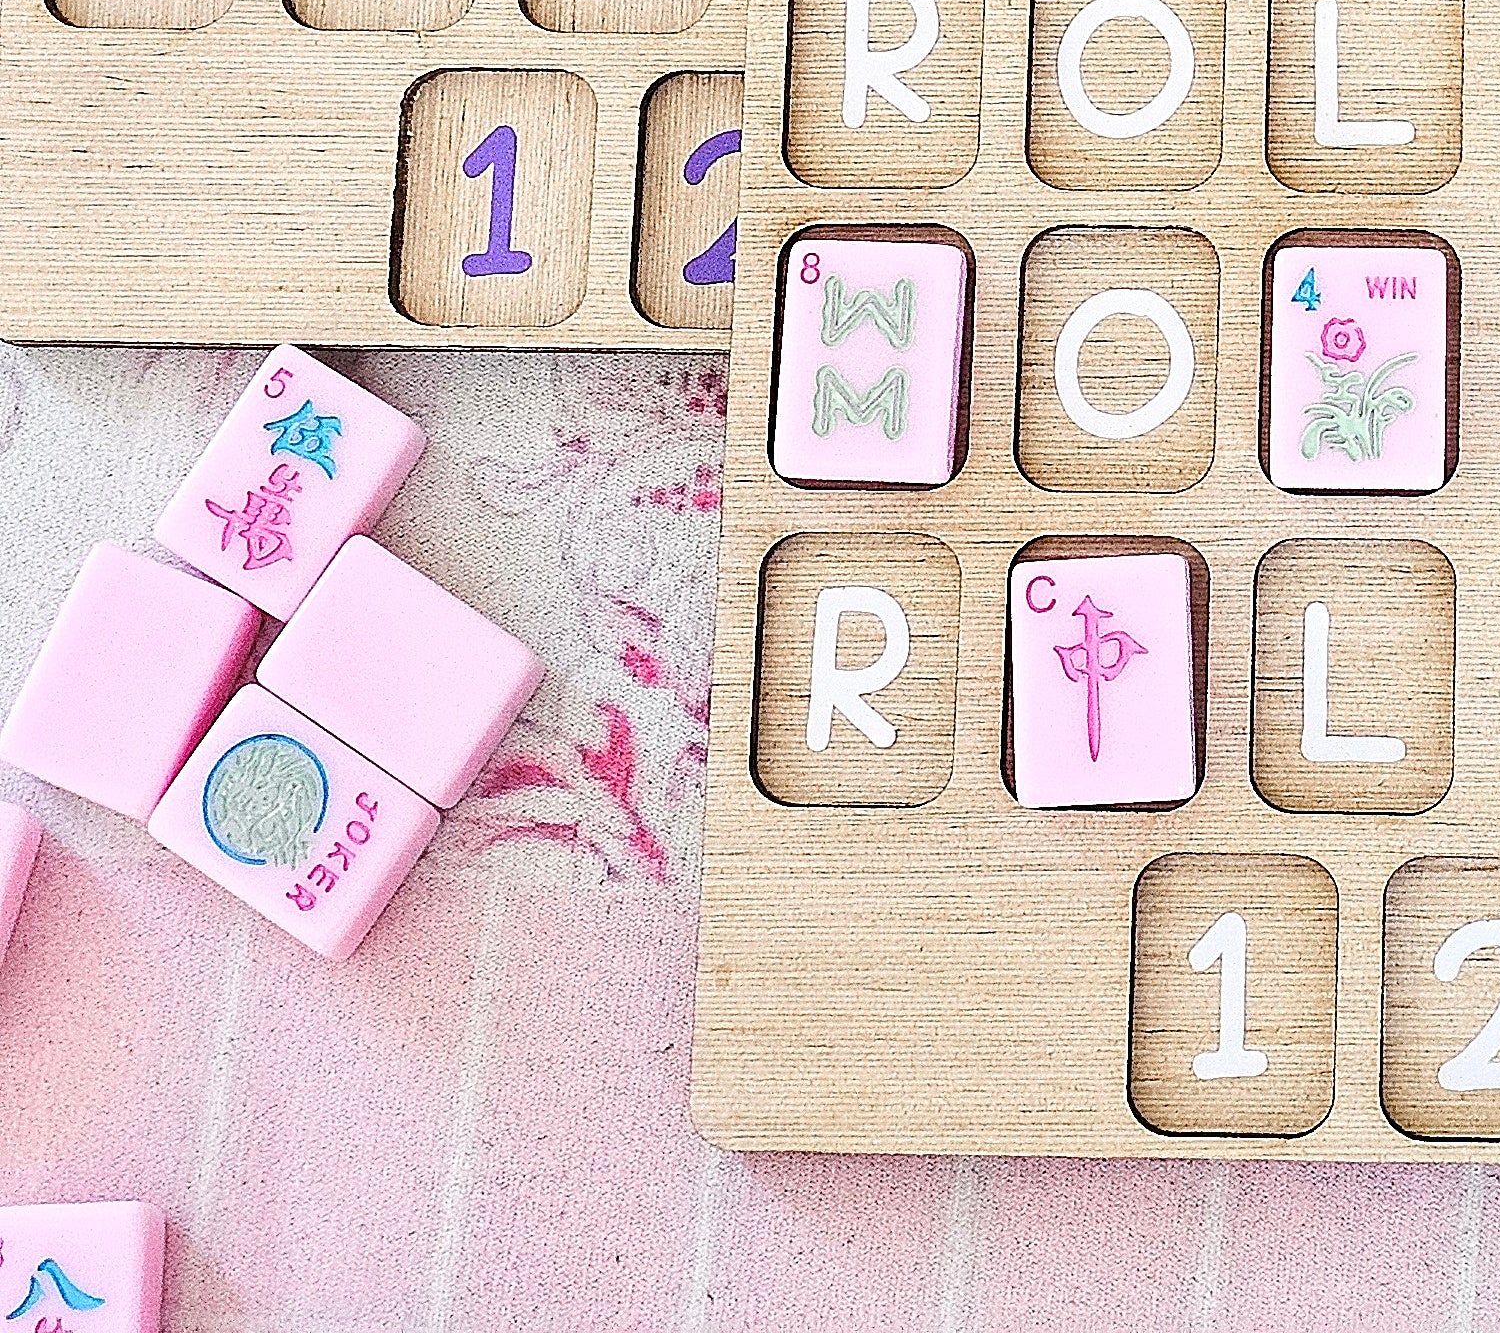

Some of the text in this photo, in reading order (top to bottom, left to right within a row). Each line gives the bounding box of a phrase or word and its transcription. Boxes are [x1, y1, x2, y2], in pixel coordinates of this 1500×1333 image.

[464, 125, 530, 278] 1
[799, 252, 821, 284] 8
[1290, 265, 1418, 312] 4 WIN
[263, 367, 294, 399] 5
[1024, 575, 1058, 614] C
[285, 790, 380, 913] JOKER
[1189, 911, 1269, 1081] 1
